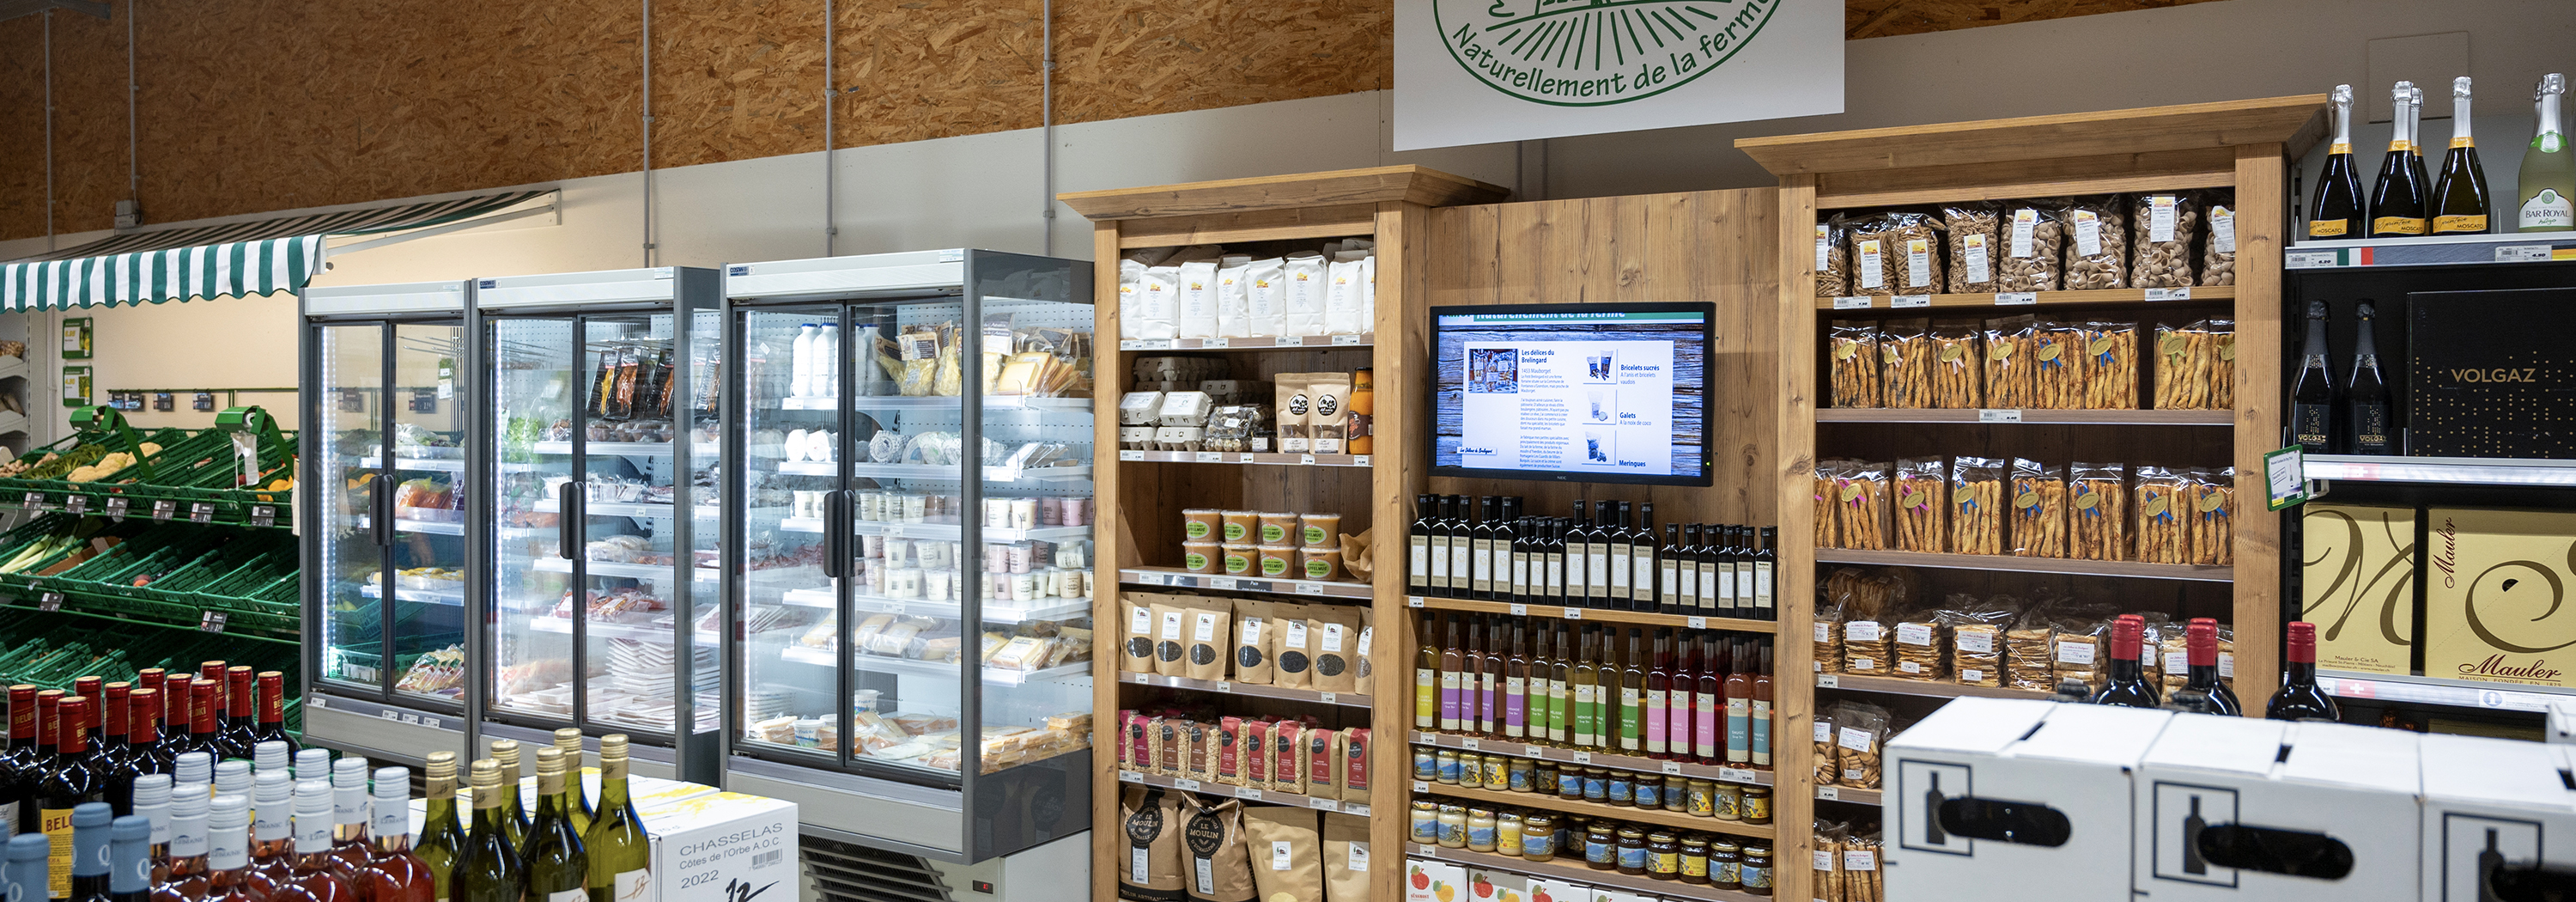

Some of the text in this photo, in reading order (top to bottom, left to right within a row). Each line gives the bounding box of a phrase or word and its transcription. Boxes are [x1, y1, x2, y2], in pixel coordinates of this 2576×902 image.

[1452, 22, 1627, 97] Naturellement
[1633, 63, 1667, 91] de
[1672, 52, 1698, 77] la
[2525, 209, 2571, 218] BAR ROYAL
[1521, 357, 1547, 365] Brelingard
[2451, 368, 2537, 384] VOLGAZ
[1619, 460, 1646, 468] Meringues
[2433, 516, 2456, 589] Mauler
[2458, 654, 2562, 679] Mauler
[680, 822, 783, 856] CHASSELAS
[1189, 828, 1218, 839] MOULIN
[98, 844, 111, 867] Q
[679, 837, 782, 870] Côtes de l'Orbe A.O.C.
[137, 857, 150, 881] Q
[681, 869, 720, 889] 2022
